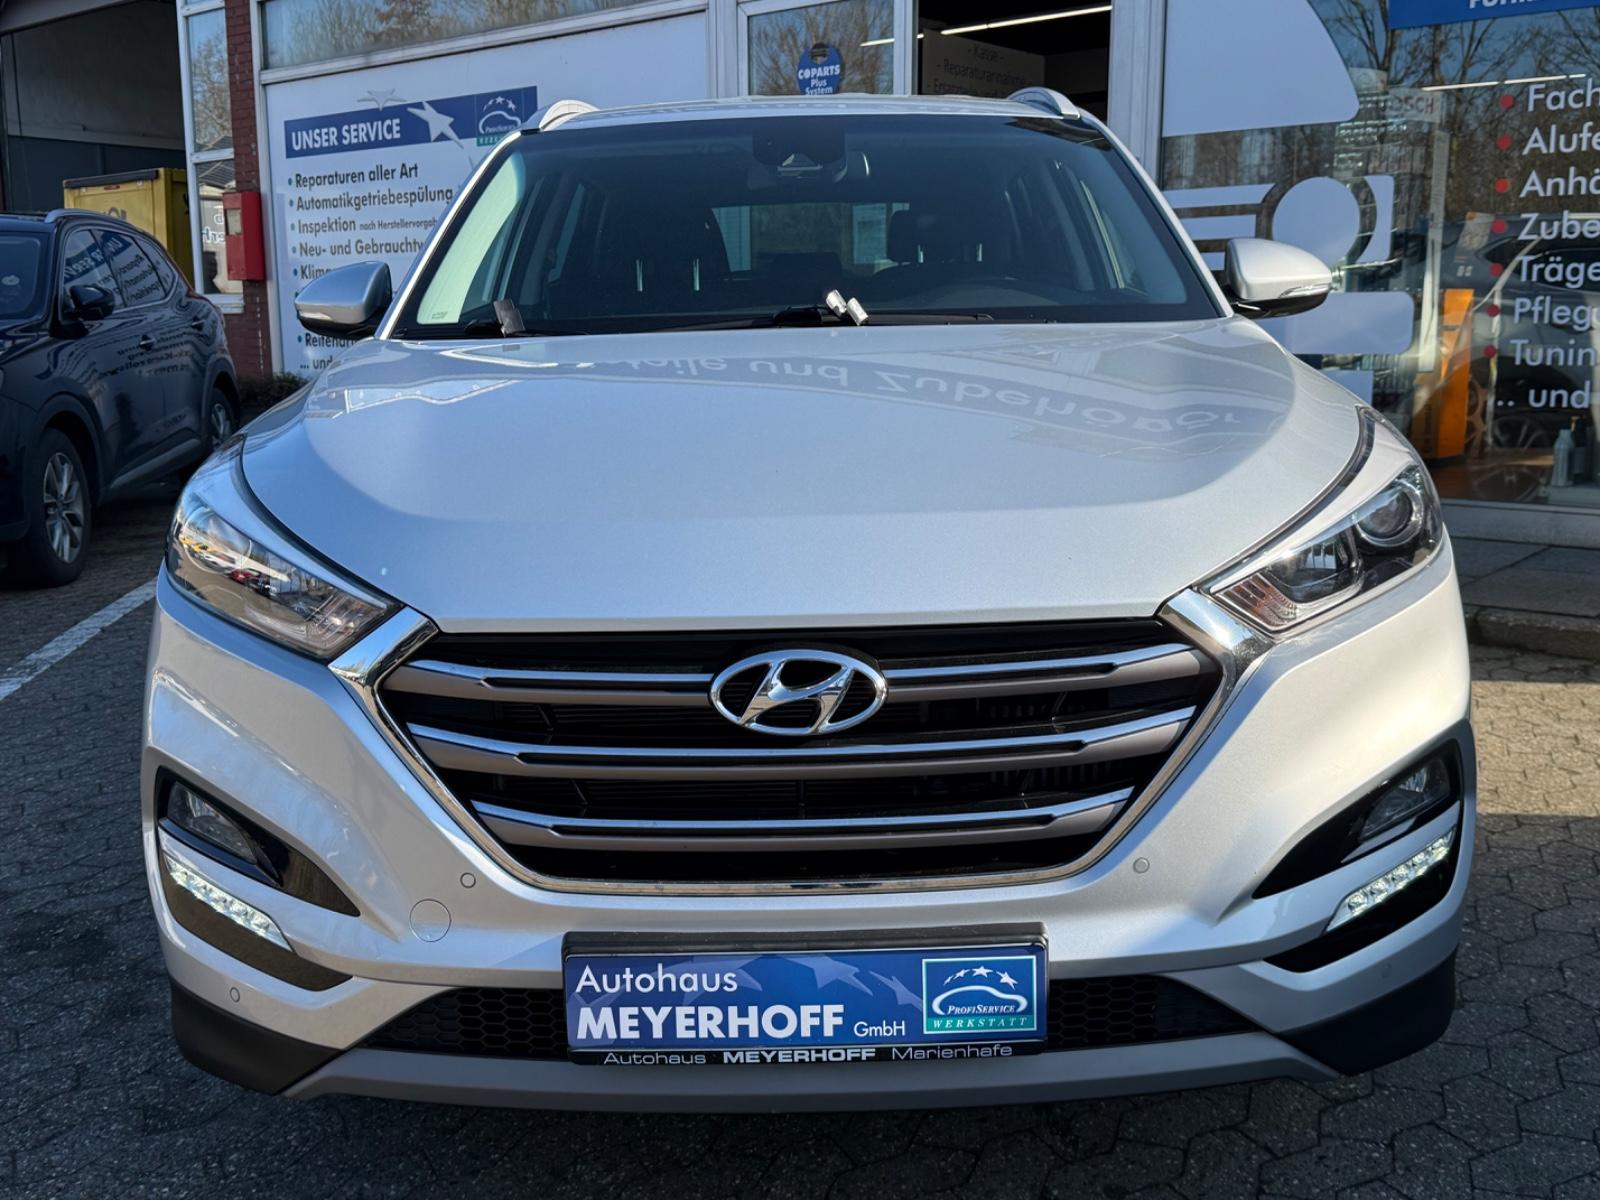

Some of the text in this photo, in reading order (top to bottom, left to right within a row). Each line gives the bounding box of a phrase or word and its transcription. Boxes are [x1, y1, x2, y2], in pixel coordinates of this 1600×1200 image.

[798, 64, 840, 80] COPARTS
[1527, 78, 1600, 112] Fach
[291, 118, 401, 151] UNSER SERVICE
[295, 162, 418, 191] Reparaturen aller Art
[296, 184, 453, 211] Automatikgetriebespülung
[298, 217, 356, 237] Inspektion
[1518, 210, 1600, 241] Zube
[300, 242, 327, 257] Neu-
[330, 239, 351, 255] und
[1515, 255, 1600, 289] Träge
[1528, 380, 1591, 409] und
[575, 962, 738, 993] Autohaus
[576, 1004, 906, 1040] MEYERHOFF GmbH
[933, 1017, 1028, 1029] WERKSTATT
[603, 1043, 1013, 1065] Autohaus MEYERHOFF Marienhafe
